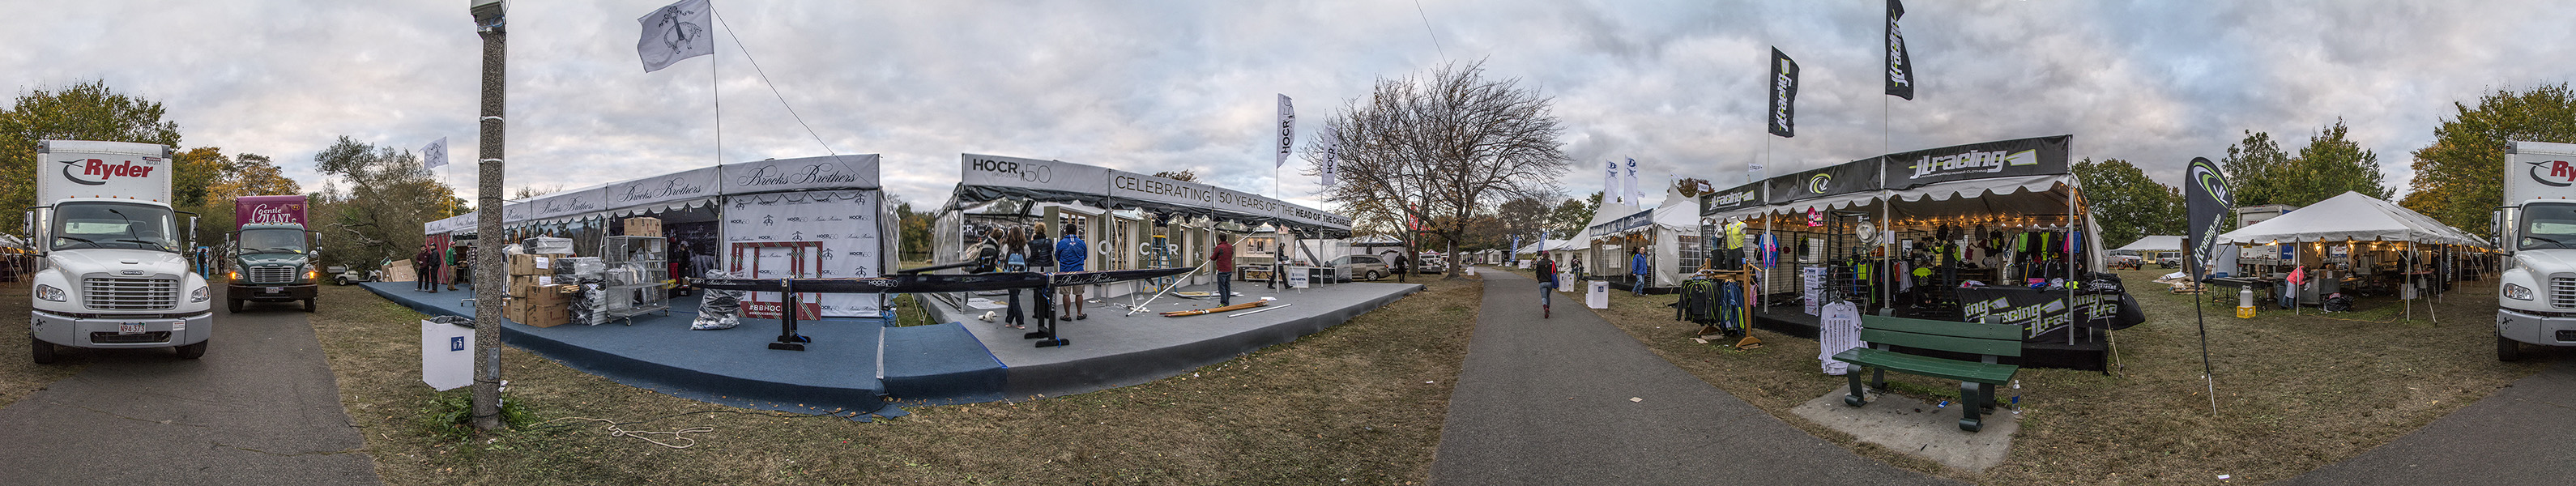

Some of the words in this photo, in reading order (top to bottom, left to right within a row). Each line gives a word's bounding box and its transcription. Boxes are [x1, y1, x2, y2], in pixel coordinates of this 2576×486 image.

[1281, 119, 1290, 154] HOCR
[84, 159, 153, 180] Ryder
[972, 158, 1017, 174] HOCR
[1024, 164, 1051, 183] 50
[1326, 147, 1336, 174] HOCR
[736, 164, 789, 187] Brooks
[790, 162, 858, 184] Brothers
[616, 182, 653, 203] Brooks
[652, 177, 703, 198] Brothers
[1115, 175, 1211, 202] CELEBRATING
[504, 207, 524, 221] Brothers
[537, 199, 562, 215] Brooks
[562, 195, 595, 212] Brothers
[1219, 191, 1232, 204] 50
[1235, 194, 1264, 211] YEARS
[1266, 202, 1277, 212] OF
[1281, 204, 1294, 216] THE
[1295, 208, 1312, 220] HEAD
[1312, 212, 1321, 222] OF
[1322, 214, 1333, 224] THE
[1333, 216, 1351, 228] CHARLES
[1054, 275, 1085, 287] Brooks
[1084, 272, 1118, 284] Brothers
